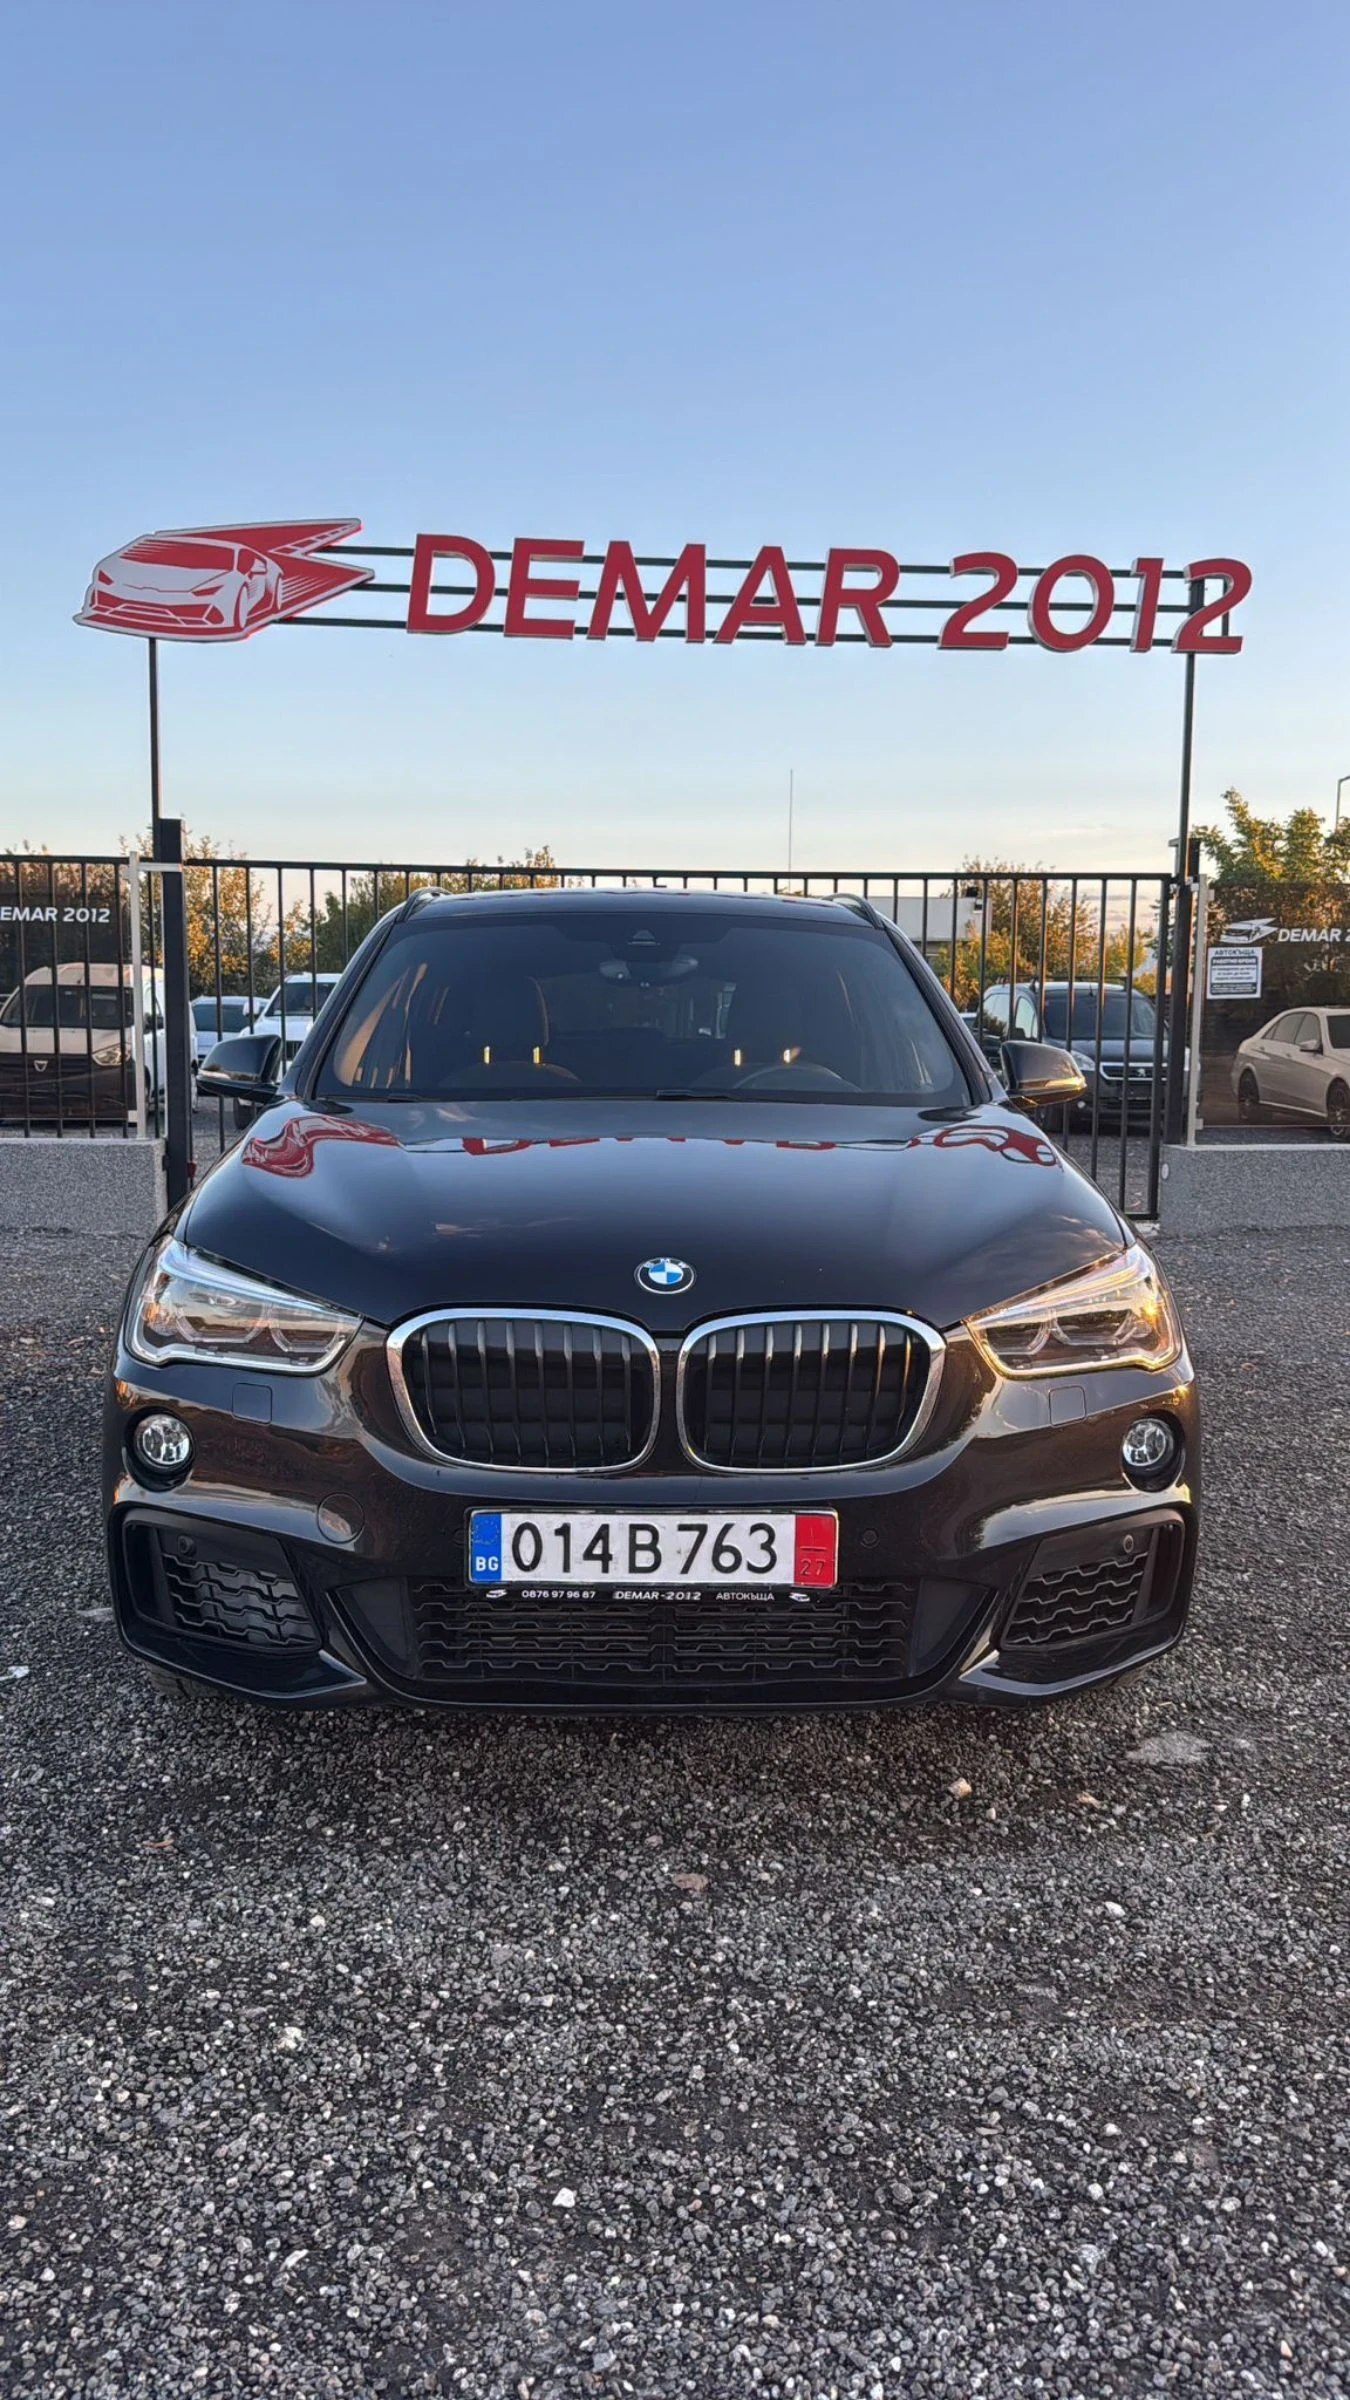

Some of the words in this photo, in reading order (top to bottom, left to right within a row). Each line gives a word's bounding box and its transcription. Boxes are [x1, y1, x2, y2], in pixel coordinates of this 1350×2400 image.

[406, 533, 900, 648] DEMAR
[938, 551, 1253, 654] 2012
[62, 907, 111, 923] 2012
[1278, 927, 1342, 942] DEMAR
[475, 1556, 499, 1571] BG
[800, 1558, 826, 1577] 27
[551, 1590, 565, 1599] 97
[716, 1592, 775, 1602] АВТОКЪЩА
